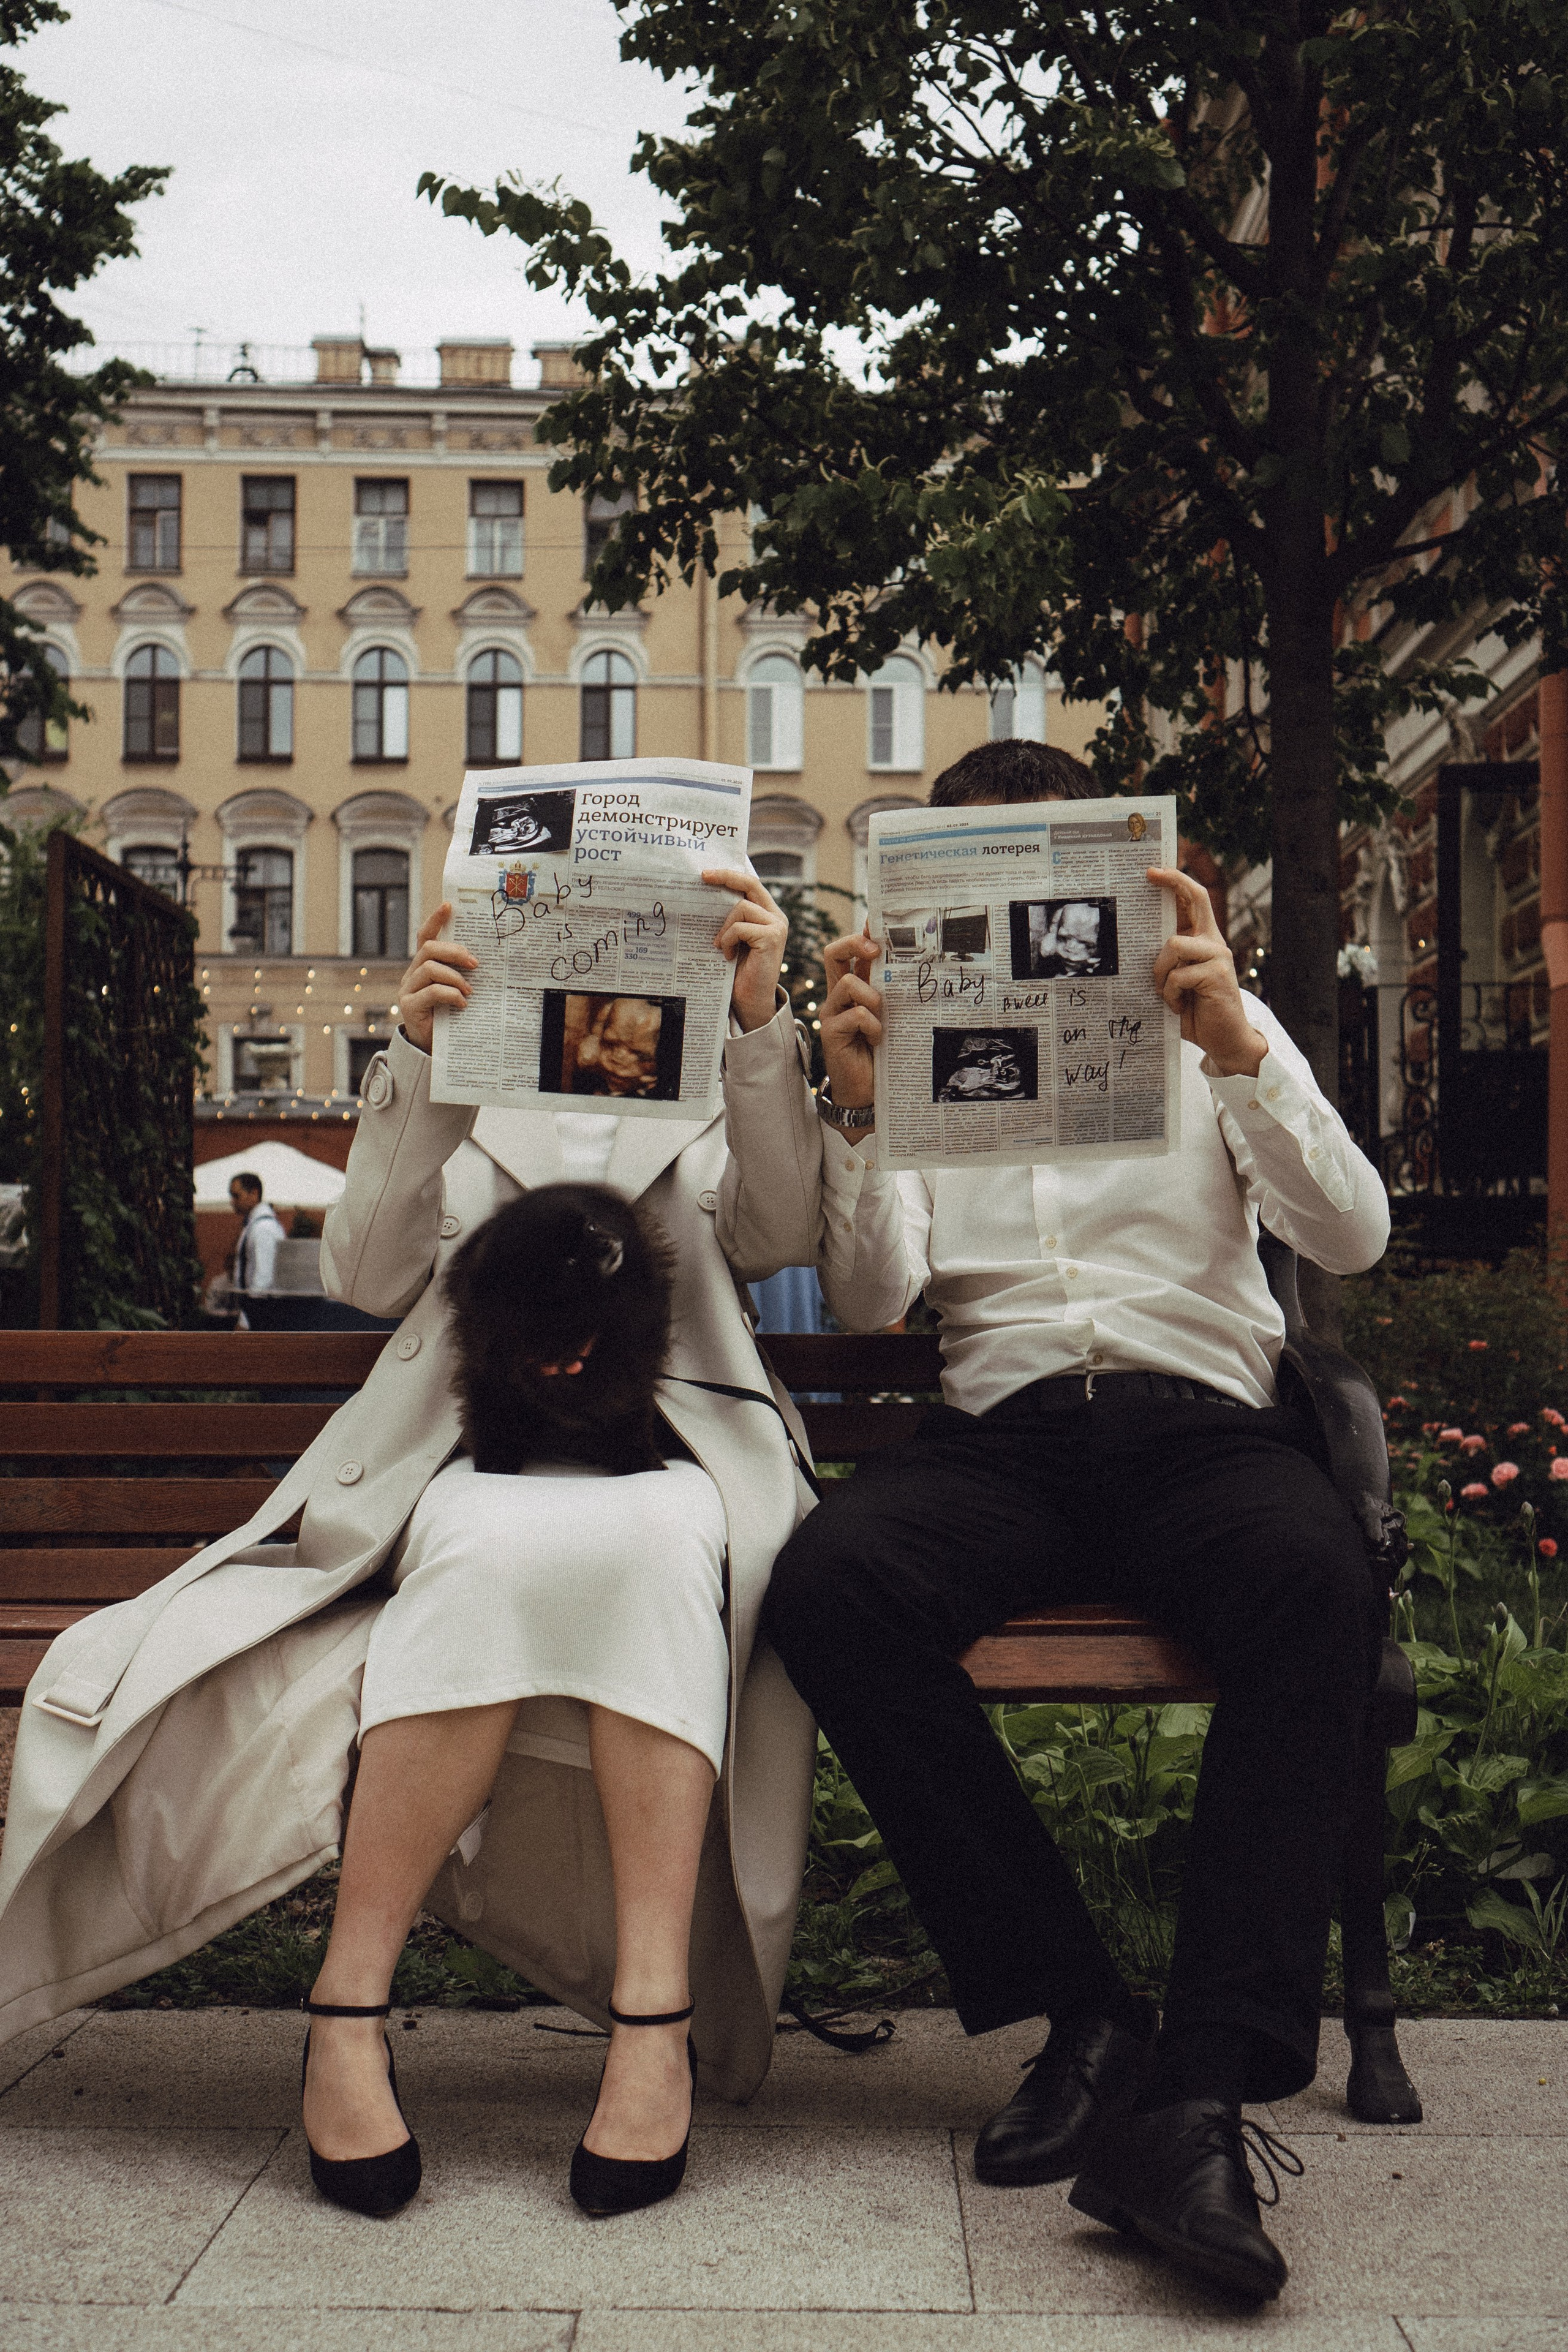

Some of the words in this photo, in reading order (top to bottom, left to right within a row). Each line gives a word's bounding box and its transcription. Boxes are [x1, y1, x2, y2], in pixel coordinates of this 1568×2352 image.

[581, 793, 639, 809] Город
[578, 812, 738, 838] демонстрирует
[575, 827, 705, 851] устойчивый
[574, 848, 622, 863] рост
[880, 847, 977, 864] Генетическая
[982, 844, 1040, 856] лотерея
[491, 872, 592, 945] Baby
[551, 902, 666, 981] coming
[918, 962, 984, 1005] Baby
[1069, 988, 1086, 1006] is
[1064, 1028, 1087, 1044] on
